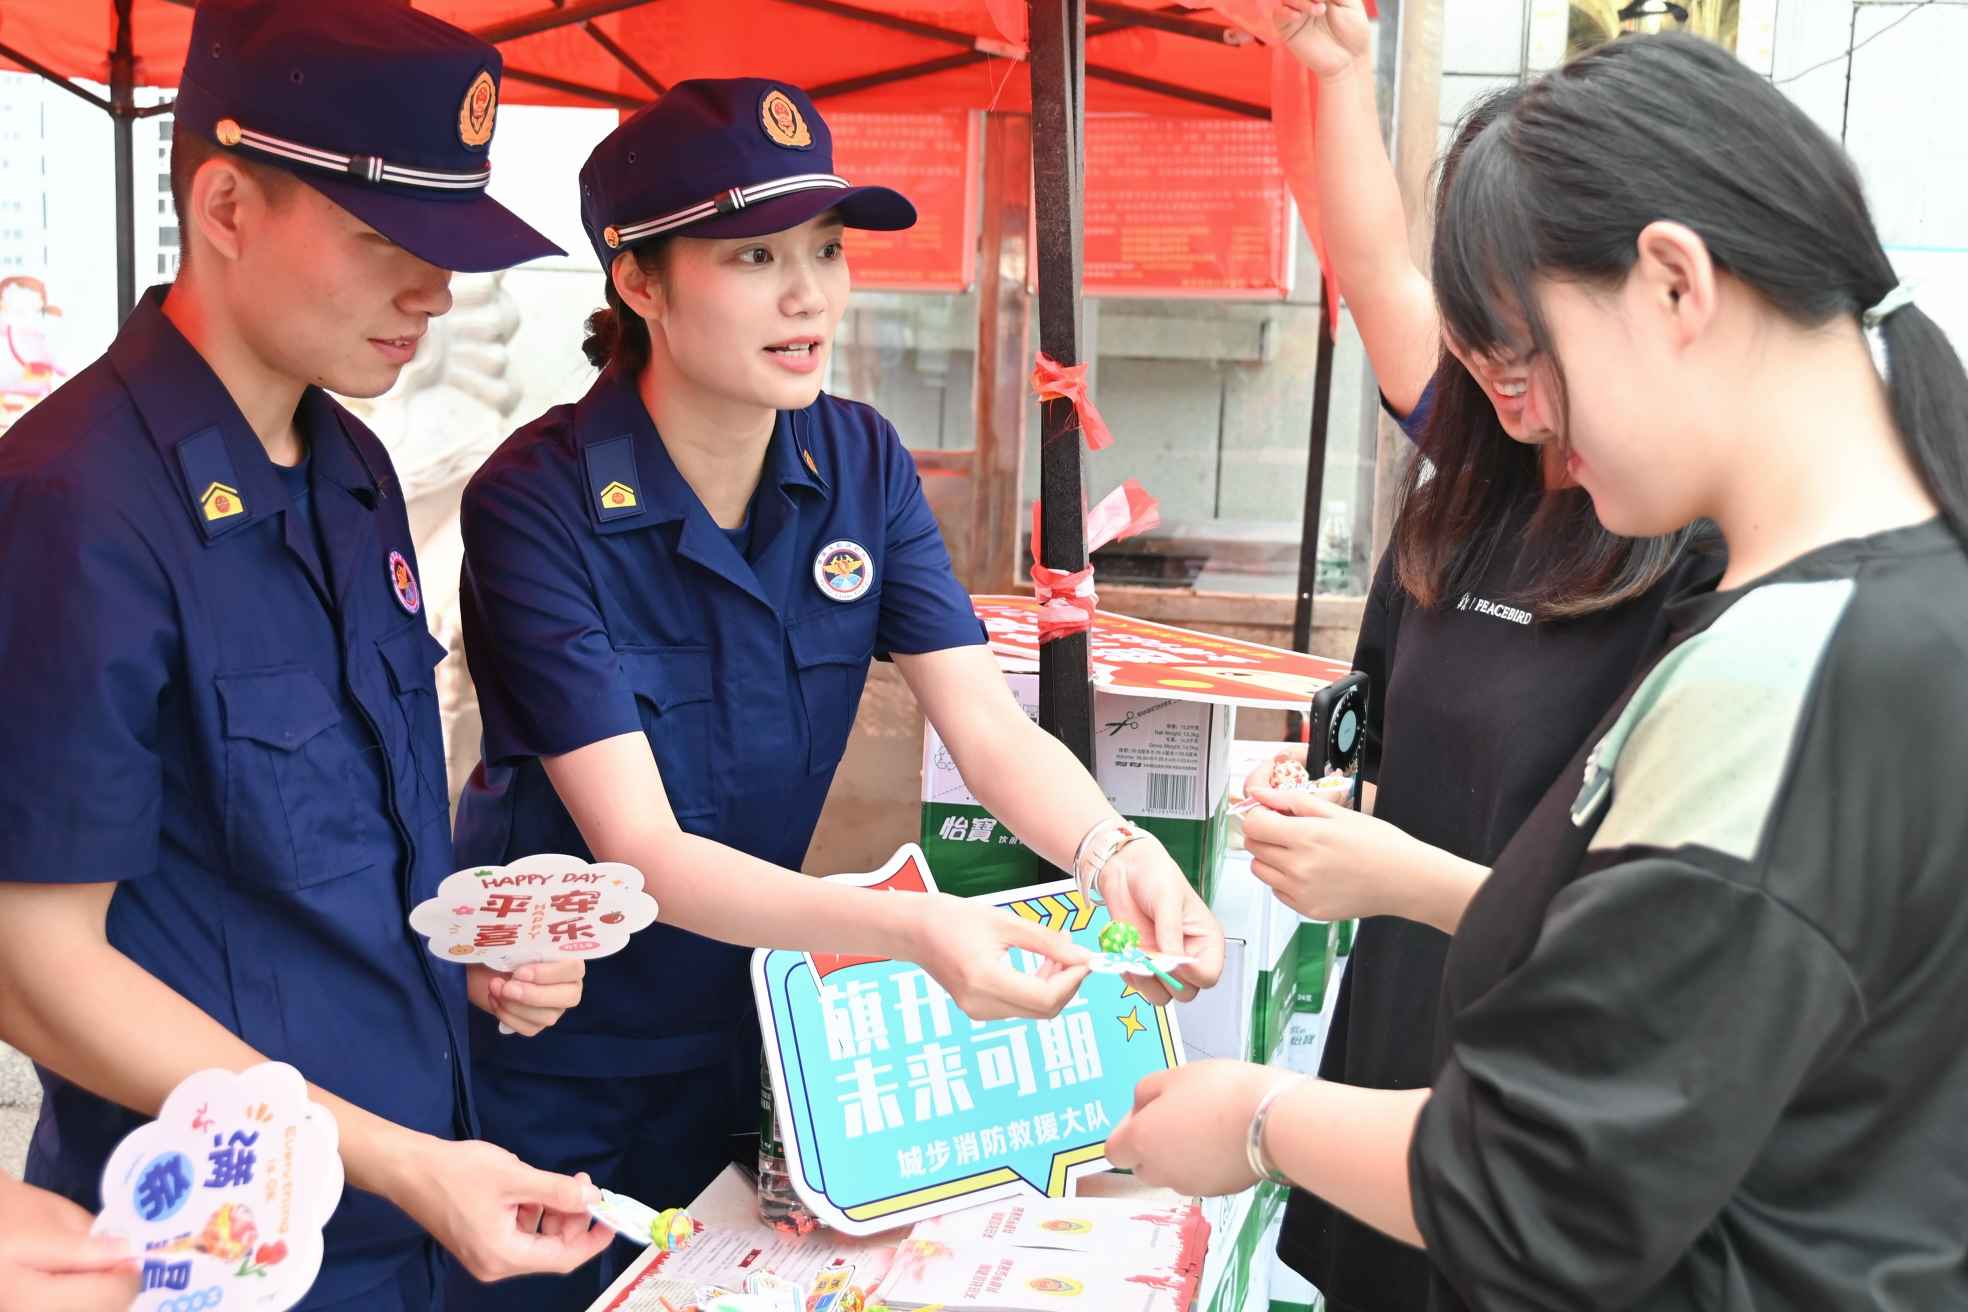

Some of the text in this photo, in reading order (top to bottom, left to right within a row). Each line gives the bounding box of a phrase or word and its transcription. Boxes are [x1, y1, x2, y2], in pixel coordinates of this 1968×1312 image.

[1474, 598, 1533, 625] PEACEBIRD
[939, 815, 997, 843] 怡寶
[481, 872, 607, 889] HAPPY DAY
[835, 1011, 1104, 1139] 未来可期
[897, 1099, 1111, 1177] 城步消防救援大队
